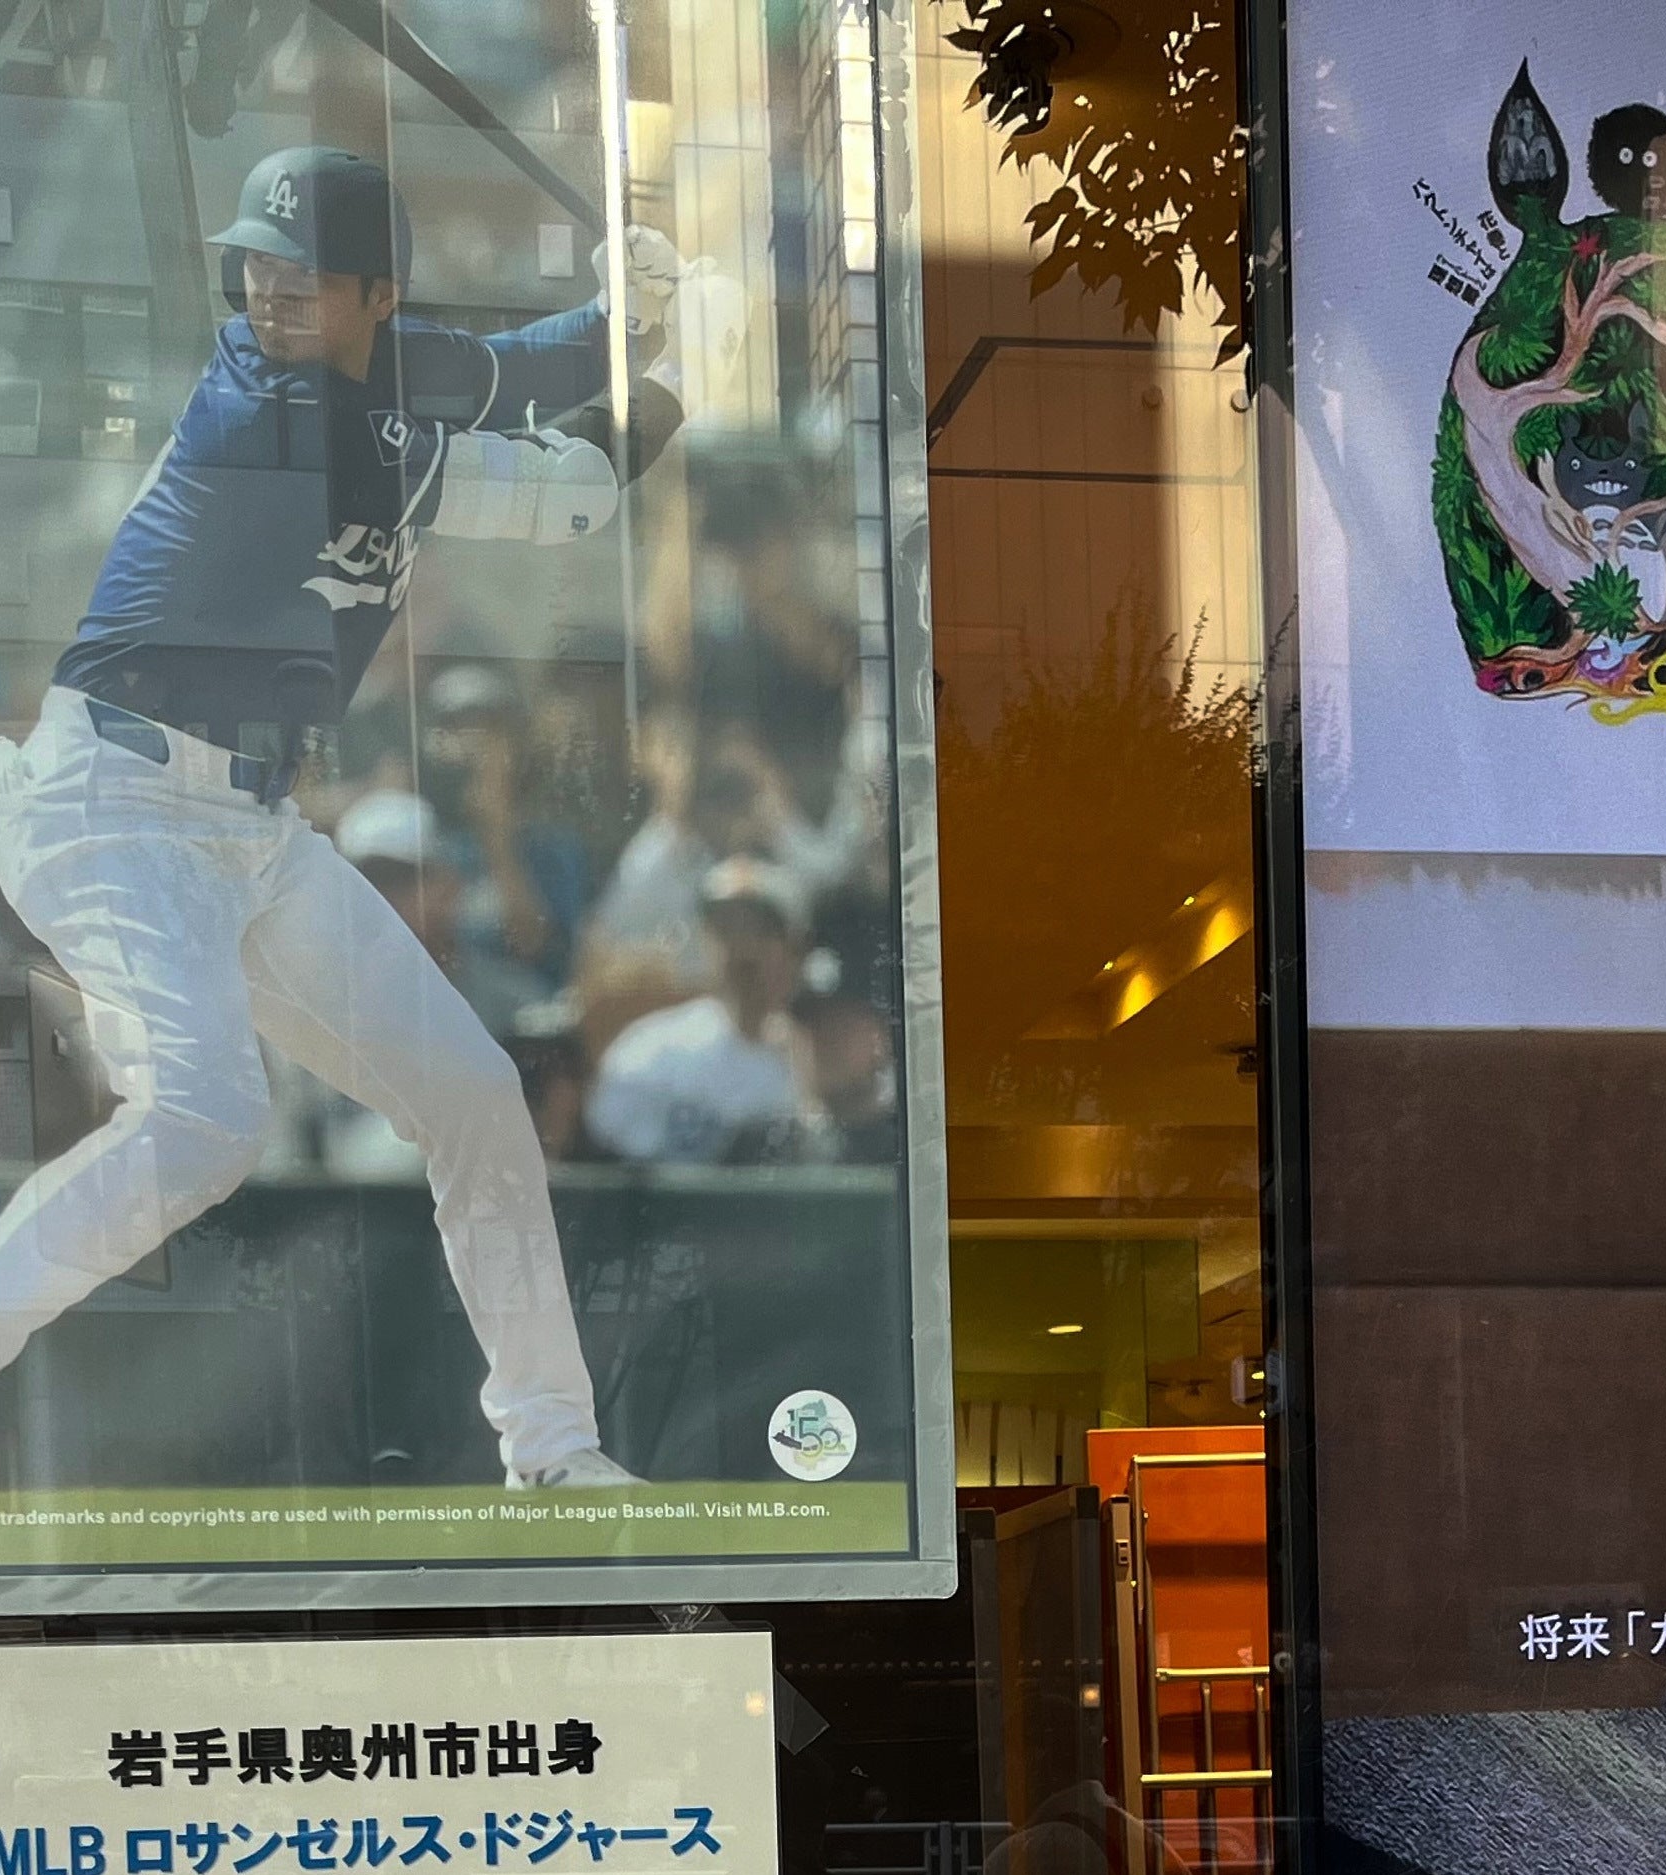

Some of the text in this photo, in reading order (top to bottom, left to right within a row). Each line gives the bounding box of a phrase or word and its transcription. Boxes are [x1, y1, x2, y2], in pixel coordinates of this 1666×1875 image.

[0, 1508, 105, 1525] trademarks
[110, 1508, 144, 1524] and
[149, 1507, 245, 1527] copyrights
[251, 1510, 279, 1523] are
[285, 1506, 328, 1522] used
[333, 1505, 371, 1522] with
[376, 1503, 473, 1525] permission
[477, 1504, 496, 1520] of
[500, 1504, 549, 1523] Major
[554, 1503, 617, 1523] League
[622, 1502, 701, 1518] Baseball.
[704, 1501, 742, 1518] Visit
[747, 1501, 831, 1517] MLB.com.
[108, 1718, 603, 1788] 岩手県奥州市出身
